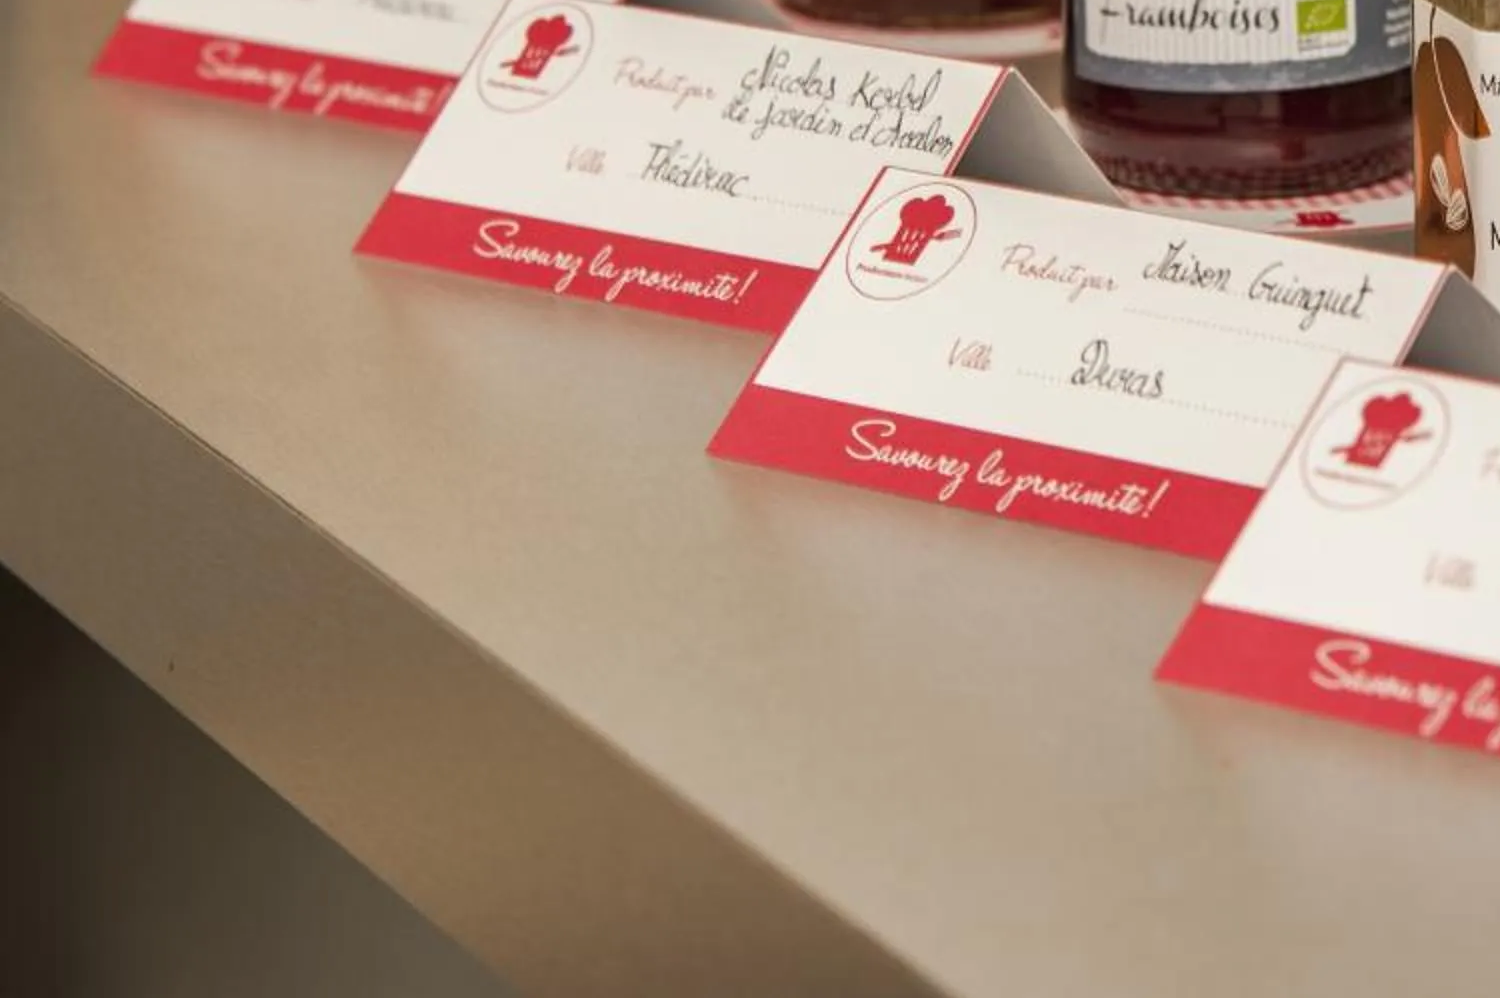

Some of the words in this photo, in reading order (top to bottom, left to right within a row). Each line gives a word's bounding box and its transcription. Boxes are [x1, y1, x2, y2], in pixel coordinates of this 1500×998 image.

[473, 219, 583, 294] Savourez
[589, 244, 620, 278] la
[1001, 242, 1086, 286] Produit
[1069, 273, 1118, 303] par
[1142, 239, 1232, 293] Maison
[1071, 338, 1164, 399] Duras
[845, 418, 970, 502] Savourez
[976, 448, 1012, 488] la
[1309, 638, 1458, 738] Savourez
